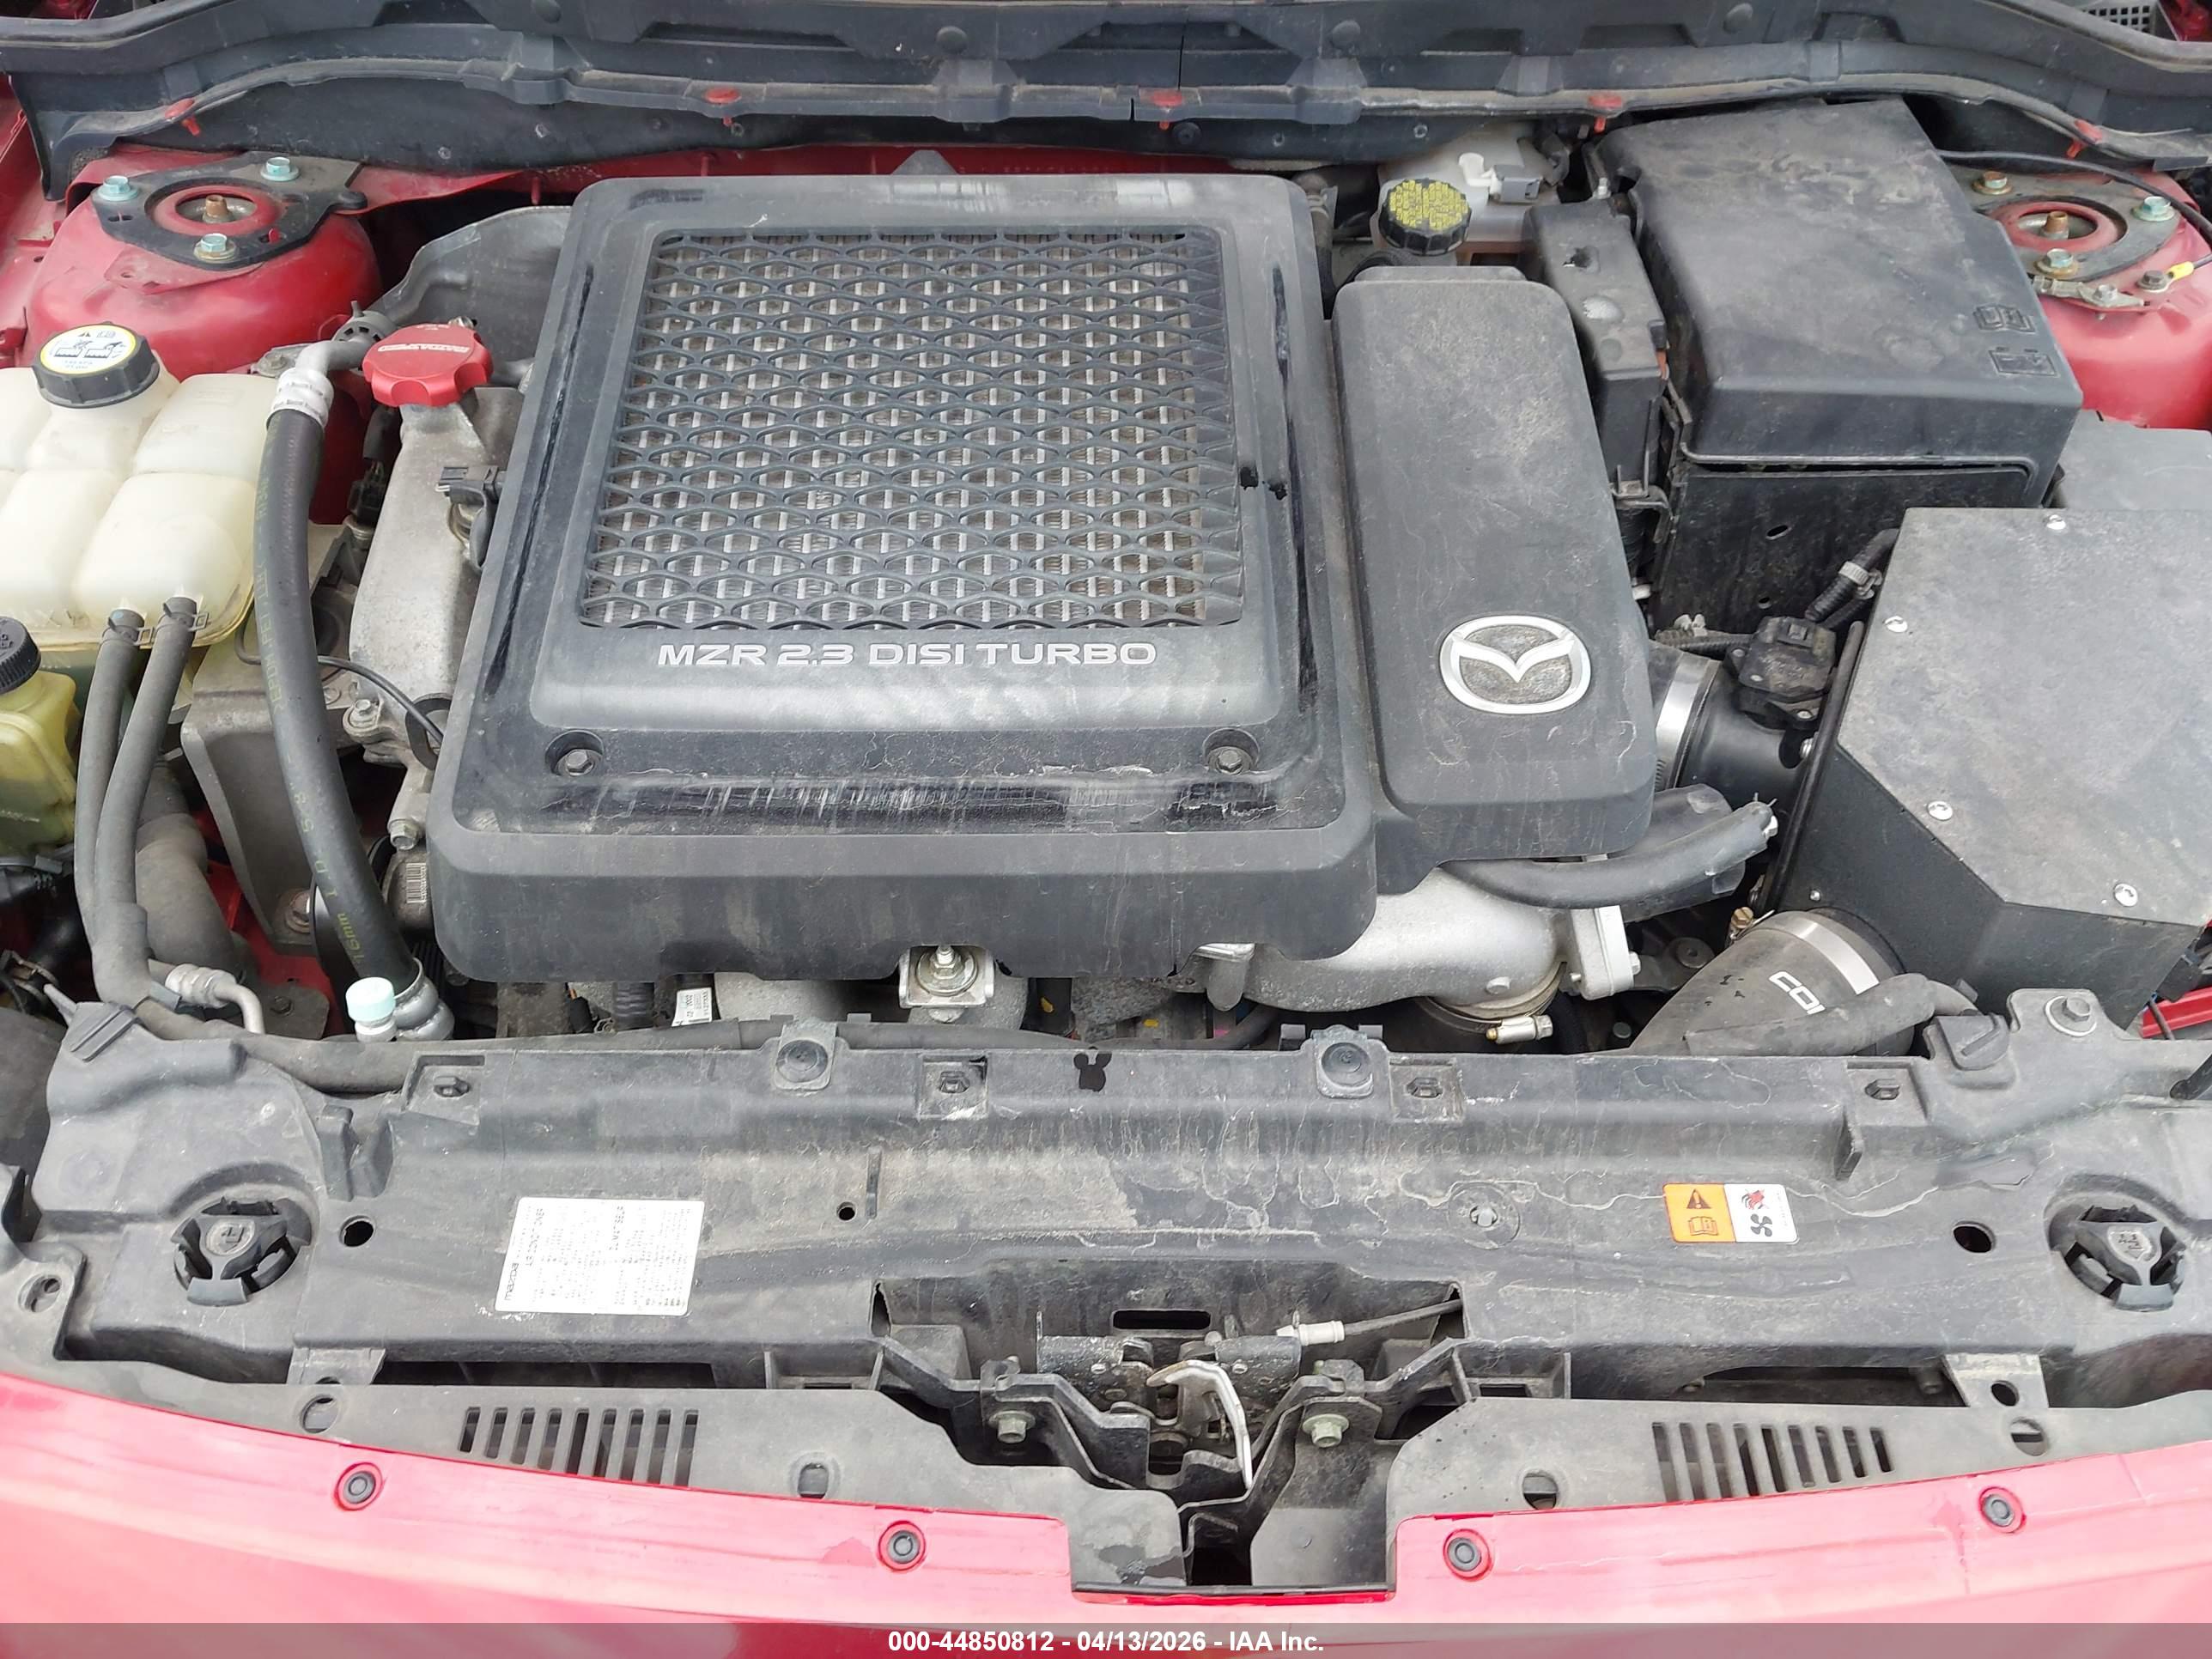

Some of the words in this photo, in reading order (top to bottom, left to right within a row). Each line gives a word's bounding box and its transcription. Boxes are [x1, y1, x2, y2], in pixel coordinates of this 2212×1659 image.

[658, 644, 767, 666] MZR
[777, 644, 854, 666] 2.3
[868, 643, 963, 665] DISI
[975, 642, 1156, 665] TURBO
